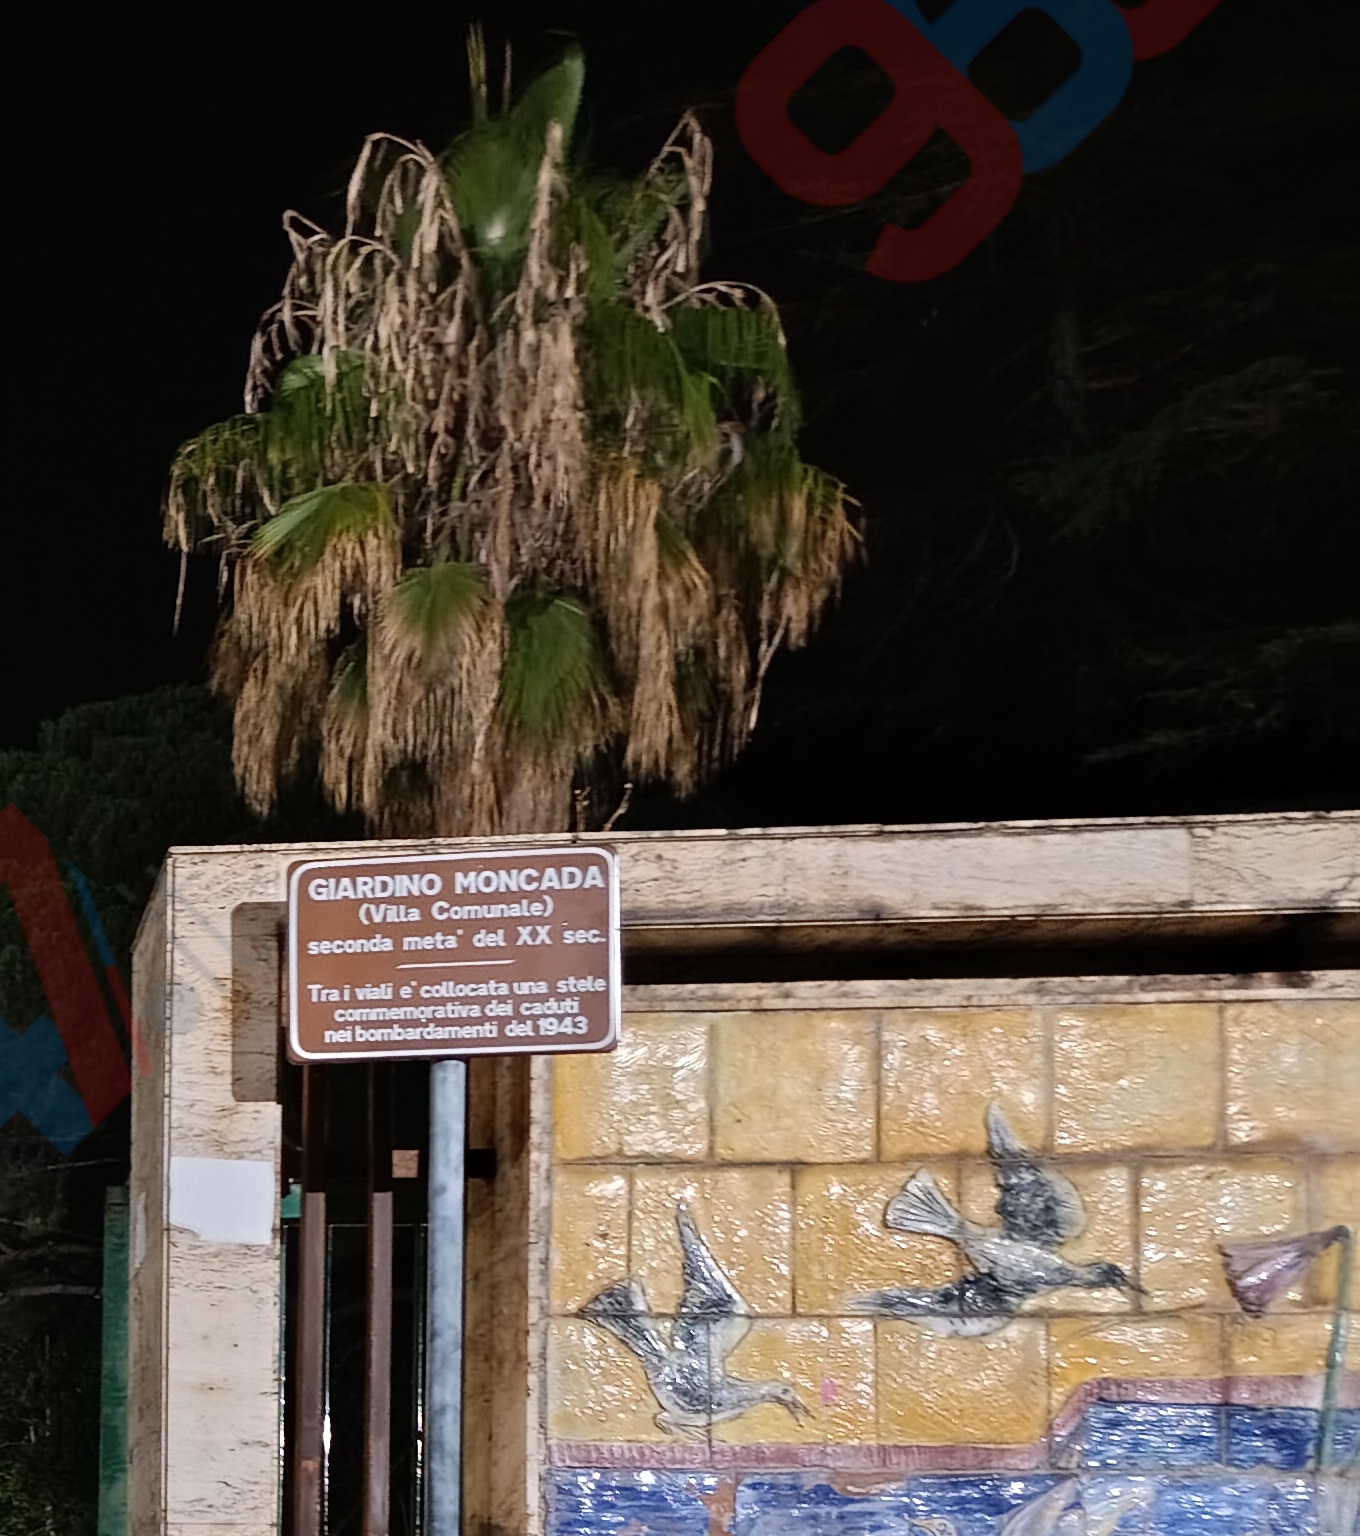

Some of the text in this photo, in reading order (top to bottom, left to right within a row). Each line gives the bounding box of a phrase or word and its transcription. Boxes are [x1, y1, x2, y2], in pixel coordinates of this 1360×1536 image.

[308, 865, 606, 901] GIARDINO MONCADA
[359, 895, 554, 925] (Villa Comunale)
[307, 933, 394, 955] seconda
[472, 929, 508, 948] del
[515, 925, 553, 945] XX
[562, 929, 606, 944] sec.
[307, 984, 340, 1002] Tra
[343, 984, 351, 1001] i
[354, 983, 394, 1000] viali
[419, 980, 510, 998] collocata
[512, 981, 549, 995] una
[556, 976, 607, 993] stele
[333, 996, 580, 1022] commemorativa dei caduti
[323, 1016, 589, 1043] nei bombardamenti del 1943
